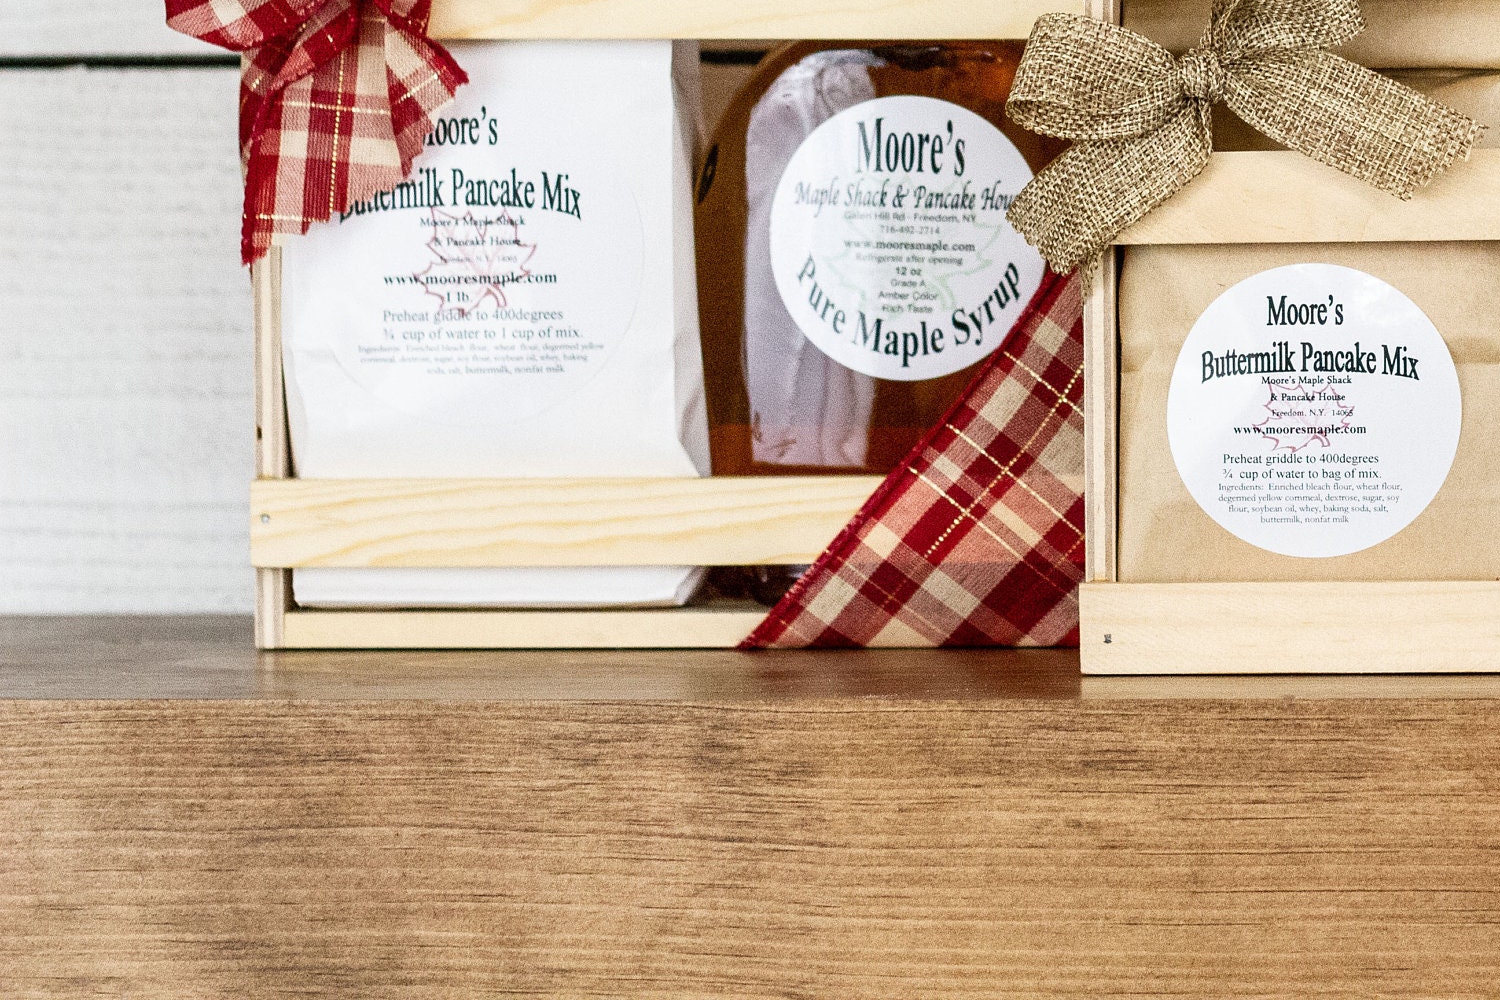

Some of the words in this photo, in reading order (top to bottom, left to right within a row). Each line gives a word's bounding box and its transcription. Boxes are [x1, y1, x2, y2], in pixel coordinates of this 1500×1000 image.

[422, 105, 498, 147] oore's
[856, 117, 966, 176] Moore's
[451, 167, 535, 210] Pancake
[541, 171, 582, 221] Mix
[794, 177, 840, 218] Maple
[843, 178, 890, 208] Shack
[891, 181, 911, 208] &
[913, 180, 977, 211] Pancake
[980, 179, 1013, 211] Hou
[895, 266, 907, 276] 12
[910, 267, 922, 277] oz
[383, 271, 557, 287] www.mooresmaple.com
[797, 251, 846, 334] Pure
[852, 310, 945, 368] Maple
[951, 262, 1021, 346] Syrup
[1266, 294, 1344, 326] Moore's
[383, 309, 429, 322] Preheat
[477, 311, 488, 322] to
[492, 309, 564, 326] 400degrees
[402, 330, 425, 343] cup
[429, 327, 443, 339] of
[447, 330, 479, 340] water
[484, 328, 496, 339] to
[502, 327, 507, 339] 1
[512, 329, 534, 342] cup
[538, 326, 552, 339] of
[555, 327, 584, 339] mix.
[1201, 340, 1296, 384] Buttermilk
[1299, 341, 1377, 375] Pancake
[1380, 344, 1420, 381] Mix
[1261, 375, 1296, 385] Moore's
[1299, 375, 1325, 387] Maple
[1327, 374, 1352, 385] Shack
[1281, 392, 1316, 401] Pancake
[1318, 392, 1346, 401] House
[1233, 424, 1367, 437] www.mooresmaple.com
[1223, 453, 1262, 464] Preheat
[1266, 453, 1302, 466] griddle
[1306, 455, 1317, 464] to
[1319, 453, 1379, 466] 400degrees
[1239, 470, 1259, 481] cup
[1261, 468, 1274, 479] of
[1276, 470, 1305, 479] water
[1308, 468, 1319, 479] to
[1322, 468, 1342, 481] bag
[1344, 468, 1357, 478] of
[1358, 468, 1382, 479] mix.
[1218, 483, 1264, 492] Ingredients:
[1268, 483, 1304, 491] Enriched
[1305, 483, 1332, 491] bleach
[1333, 482, 1354, 491] flour,
[1356, 483, 1379, 491] wheat
[1381, 482, 1403, 491] flour,
[1258, 493, 1282, 503] yellow
[1325, 494, 1360, 503] dextrose,
[1362, 495, 1385, 504] sugar,
[1387, 495, 1400, 504] soy
[1228, 504, 1250, 514] flour,
[1251, 504, 1283, 515] soybean
[1285, 504, 1297, 514] oil,
[1299, 505, 1322, 515] whey,
[1323, 504, 1349, 515] baking
[1351, 504, 1371, 514] soda,
[1373, 504, 1389, 514] salt,
[1260, 515, 1303, 525] buttermilk,
[1304, 515, 1331, 524] nonfat
[1332, 515, 1350, 524] milk
